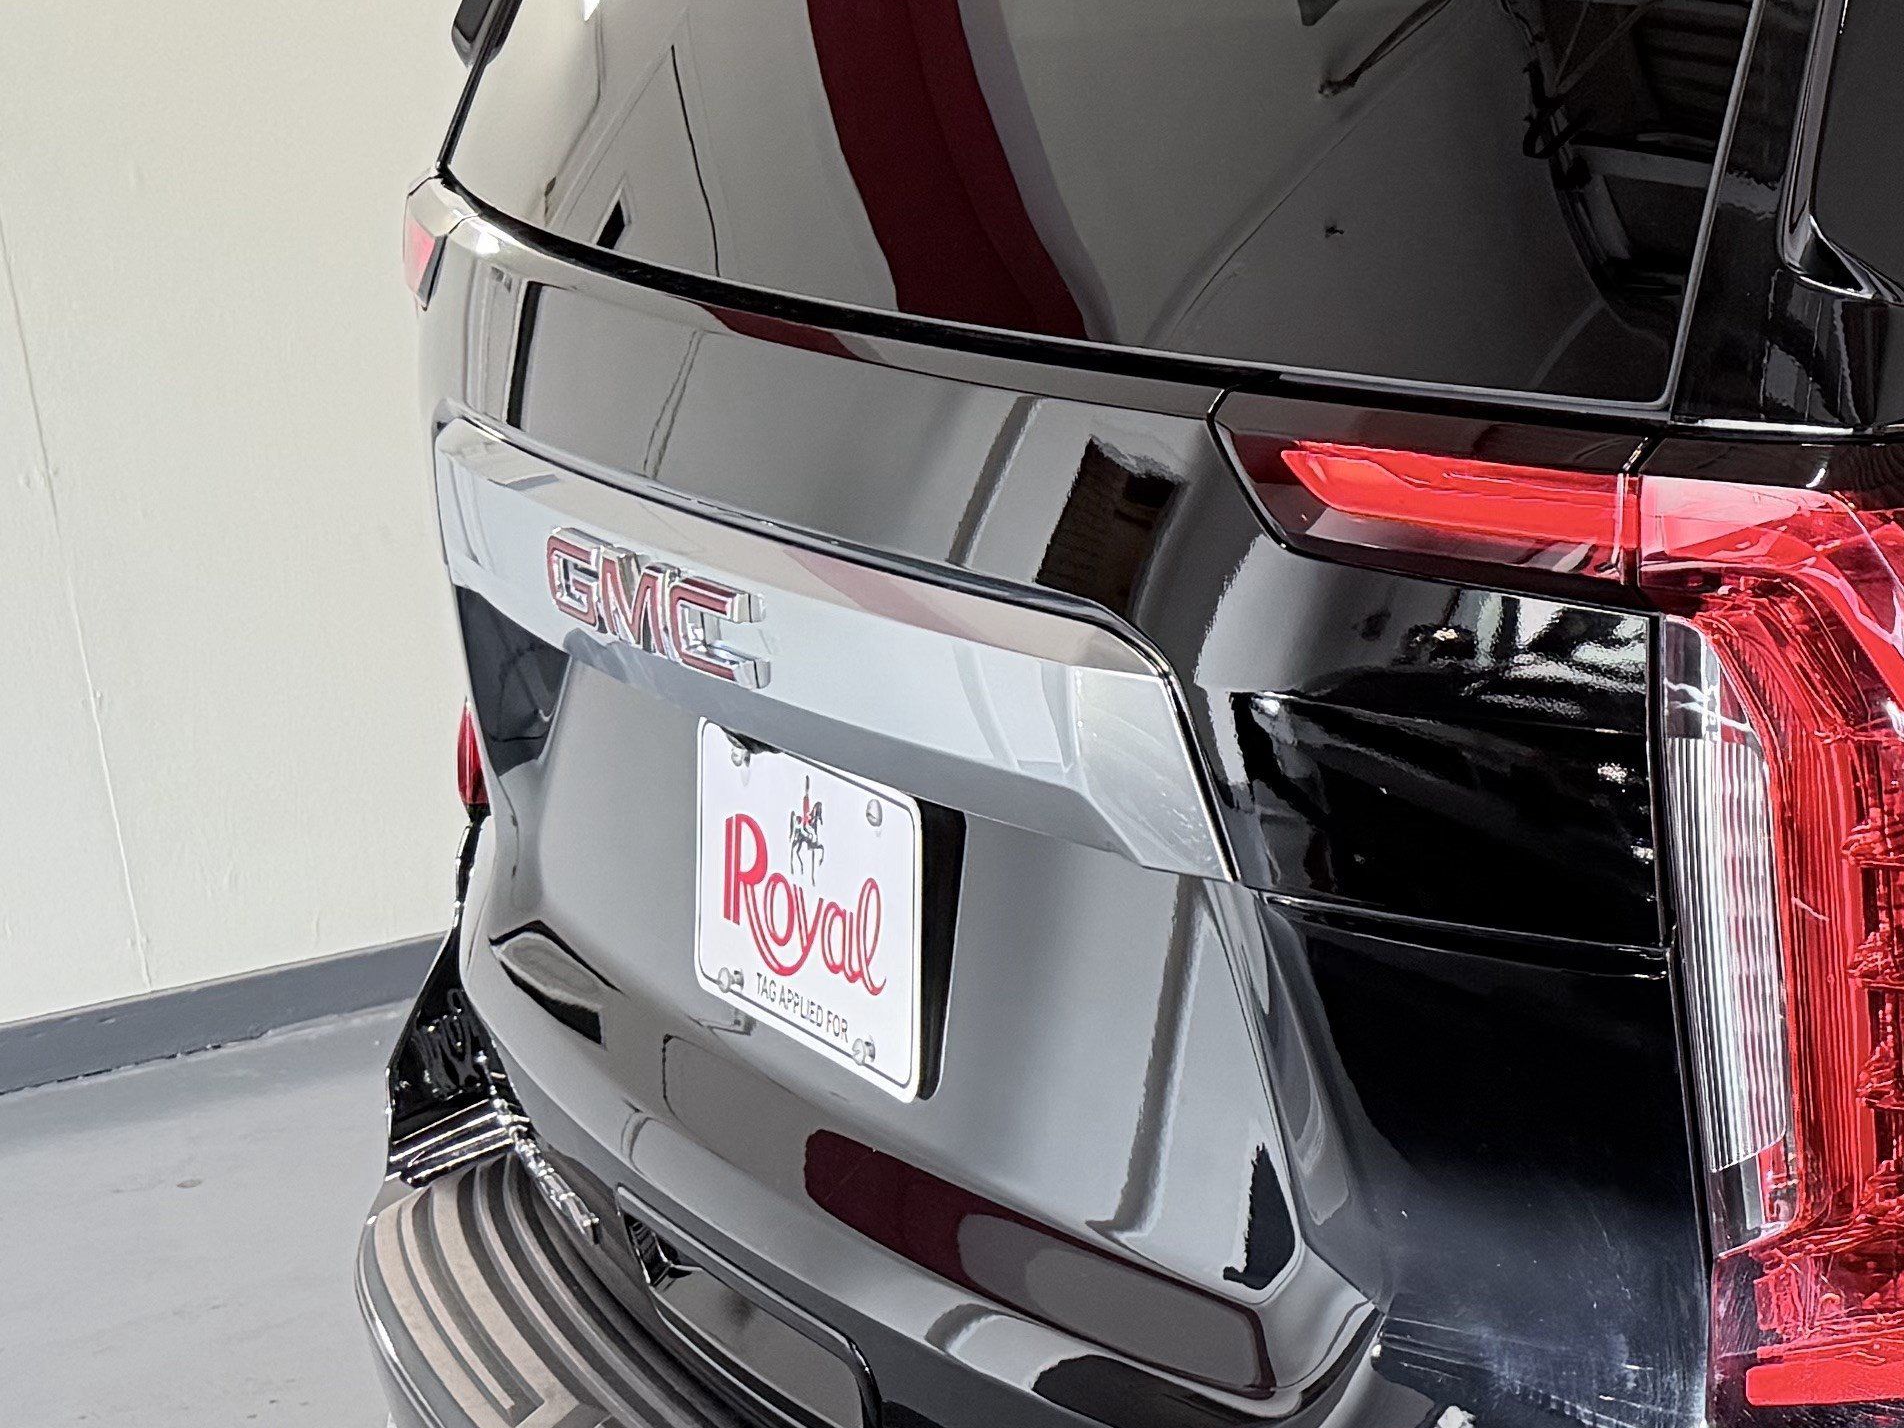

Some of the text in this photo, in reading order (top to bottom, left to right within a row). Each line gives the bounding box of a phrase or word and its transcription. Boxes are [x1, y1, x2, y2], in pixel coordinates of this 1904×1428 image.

[546, 526, 772, 690] GMC
[723, 813, 887, 996] Royal
[756, 972, 849, 1044] TAG APPLIED FOR
